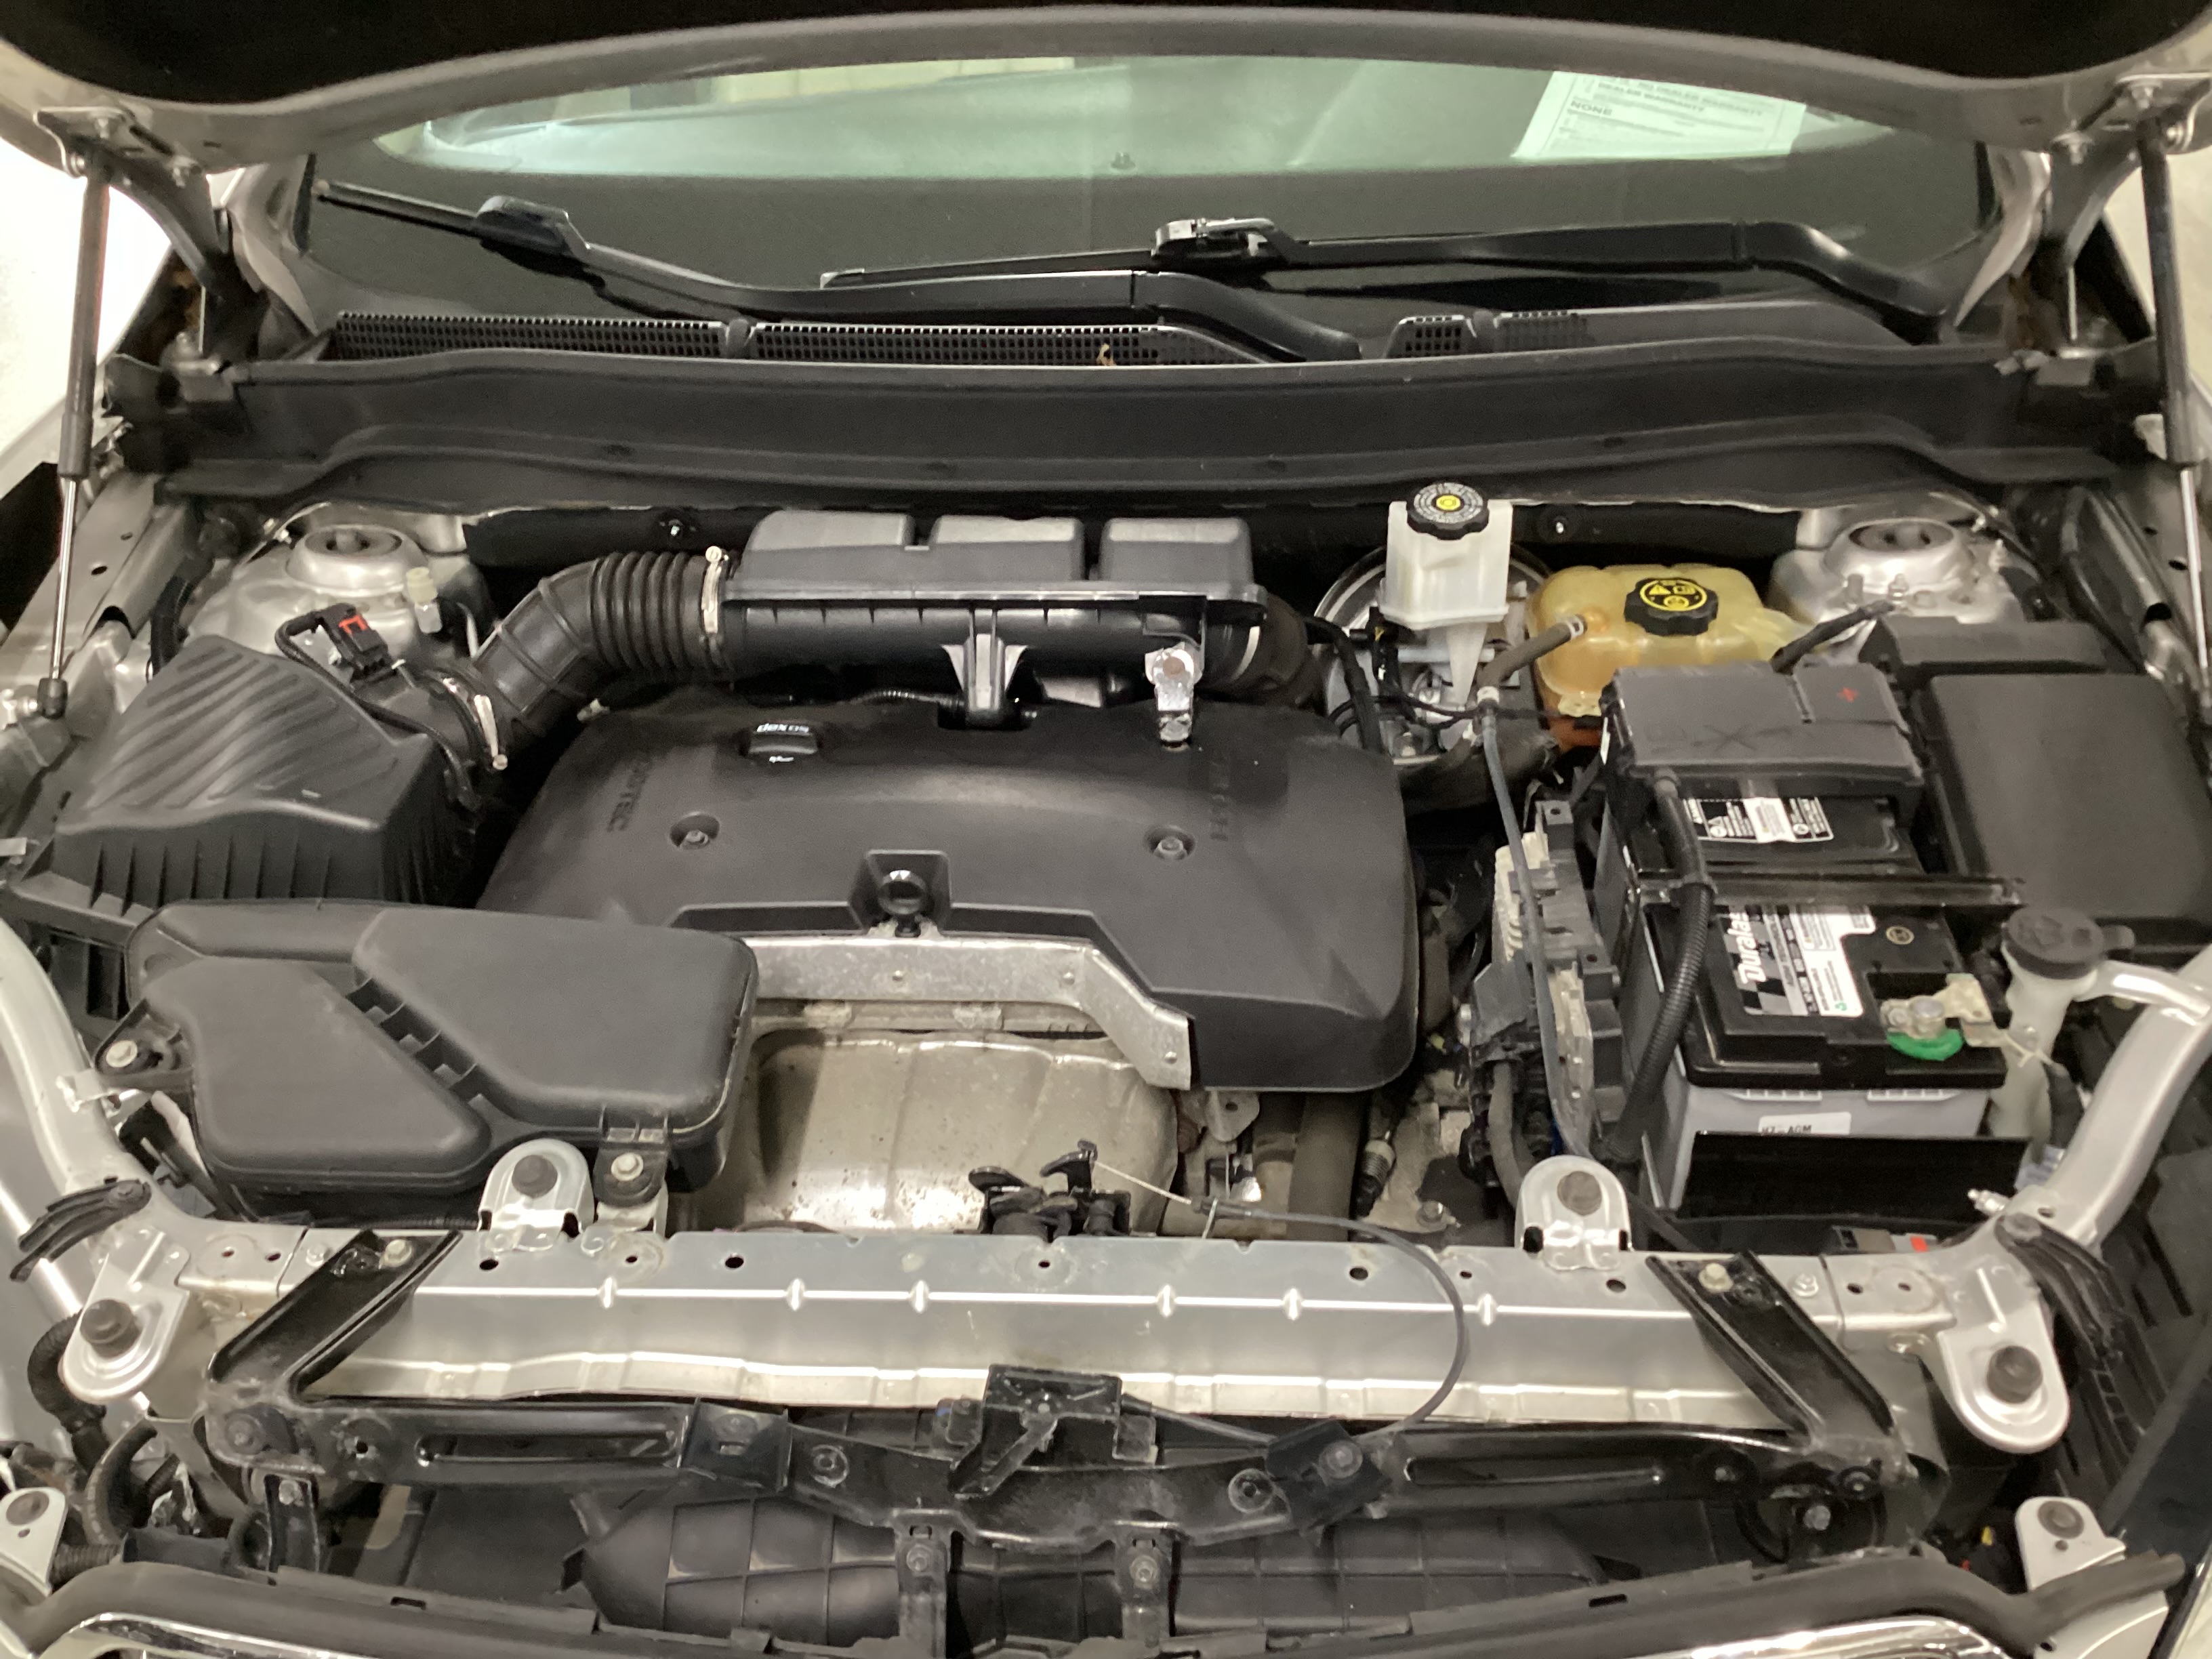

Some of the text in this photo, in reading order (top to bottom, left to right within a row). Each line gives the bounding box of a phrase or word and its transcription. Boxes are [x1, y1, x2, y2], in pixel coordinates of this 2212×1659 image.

[1570, 100, 1613, 117] NONE
[1597, 81, 1642, 98] DEALER
[1643, 91, 1705, 112] WARRANTY
[1727, 912, 1767, 985] Duralas
